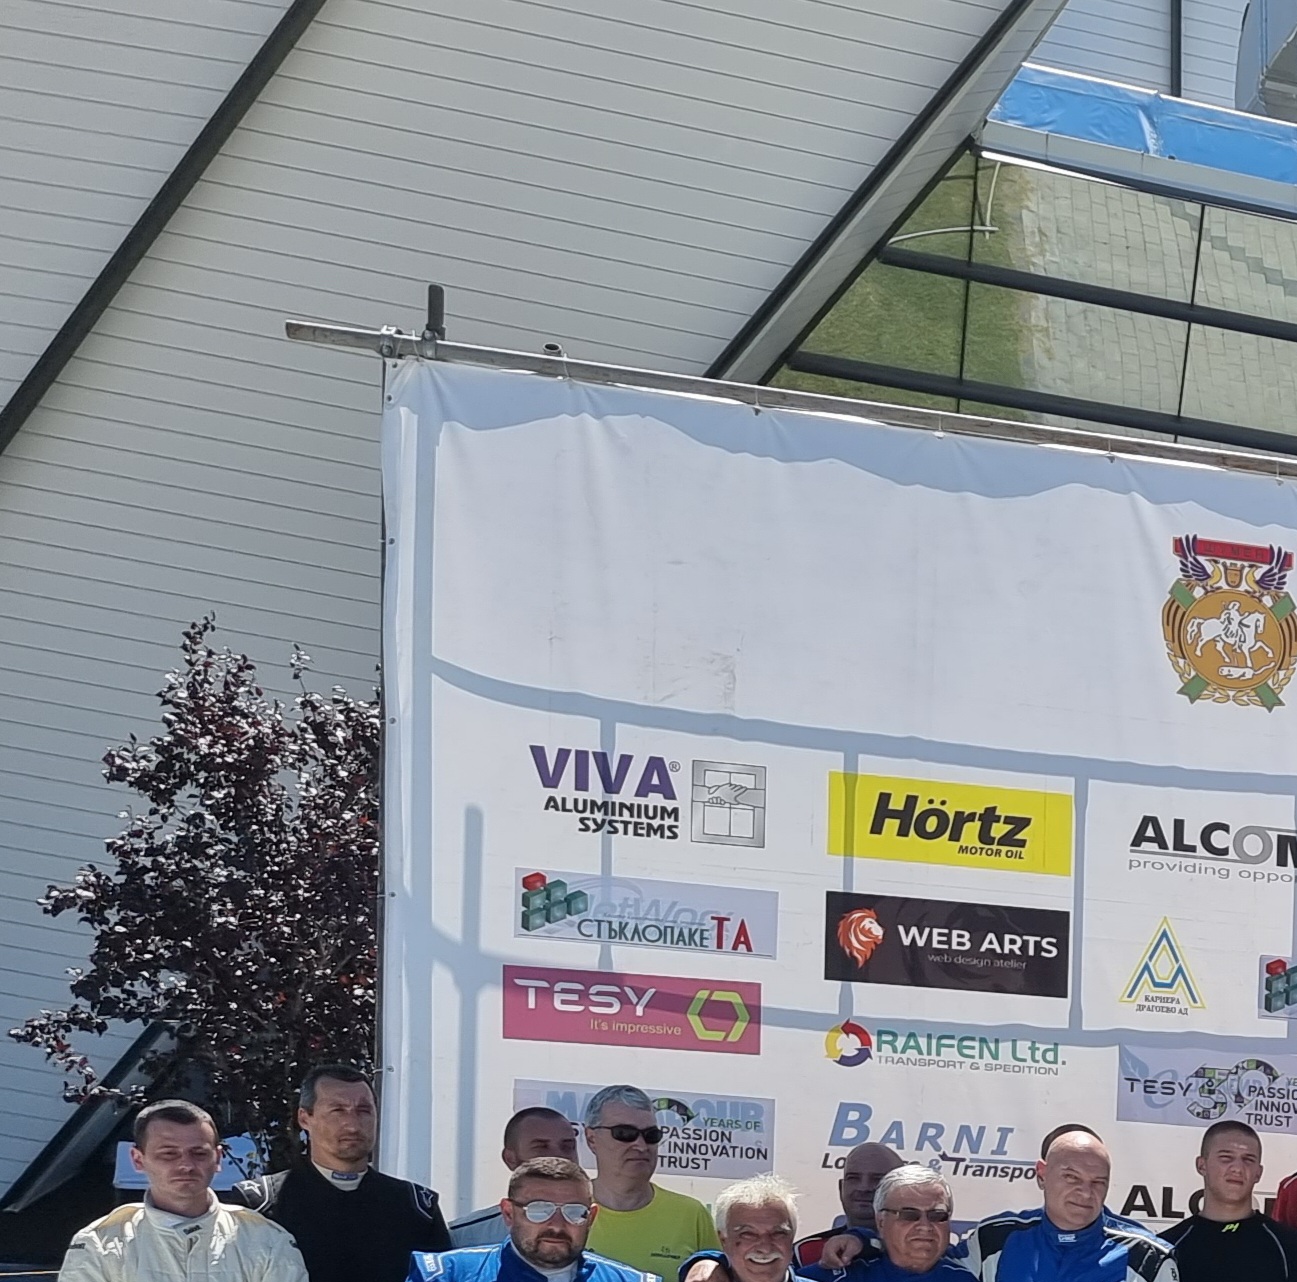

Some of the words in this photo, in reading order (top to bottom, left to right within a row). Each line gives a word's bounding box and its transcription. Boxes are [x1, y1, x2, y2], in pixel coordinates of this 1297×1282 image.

[530, 745, 678, 800] VIVA
[544, 796, 679, 823] ALUMINIUM
[869, 792, 1032, 848] Hörtz
[578, 817, 679, 840] SYSTEMS
[957, 845, 1002, 858] MOTOR
[1005, 848, 1024, 860] OIL
[1128, 857, 1230, 880] providing
[898, 924, 971, 951] WEB
[980, 931, 1058, 958] ARTS
[928, 952, 953, 965] web
[955, 955, 987, 969] design
[989, 957, 1027, 970] atelier
[514, 978, 657, 1017] TESY
[590, 1018, 608, 1031] It's
[612, 1021, 682, 1037] impressive
[877, 1029, 1001, 1060] RAIFEN
[1011, 1038, 1067, 1066] Ltd.
[878, 1055, 968, 1071] TRANSPORT
[970, 1061, 980, 1071] &
[984, 1062, 1059, 1076] SPEDITION
[1124, 1077, 1193, 1097] TESY
[703, 1117, 741, 1130] YEARS
[745, 1120, 761, 1131] OF
[829, 1102, 1015, 1156] BARNI
[1245, 1112, 1293, 1128] TRUST
[661, 1126, 732, 1143] PASSION
[668, 1140, 768, 1161] INNOVATION
[657, 1154, 711, 1171] TRUST
